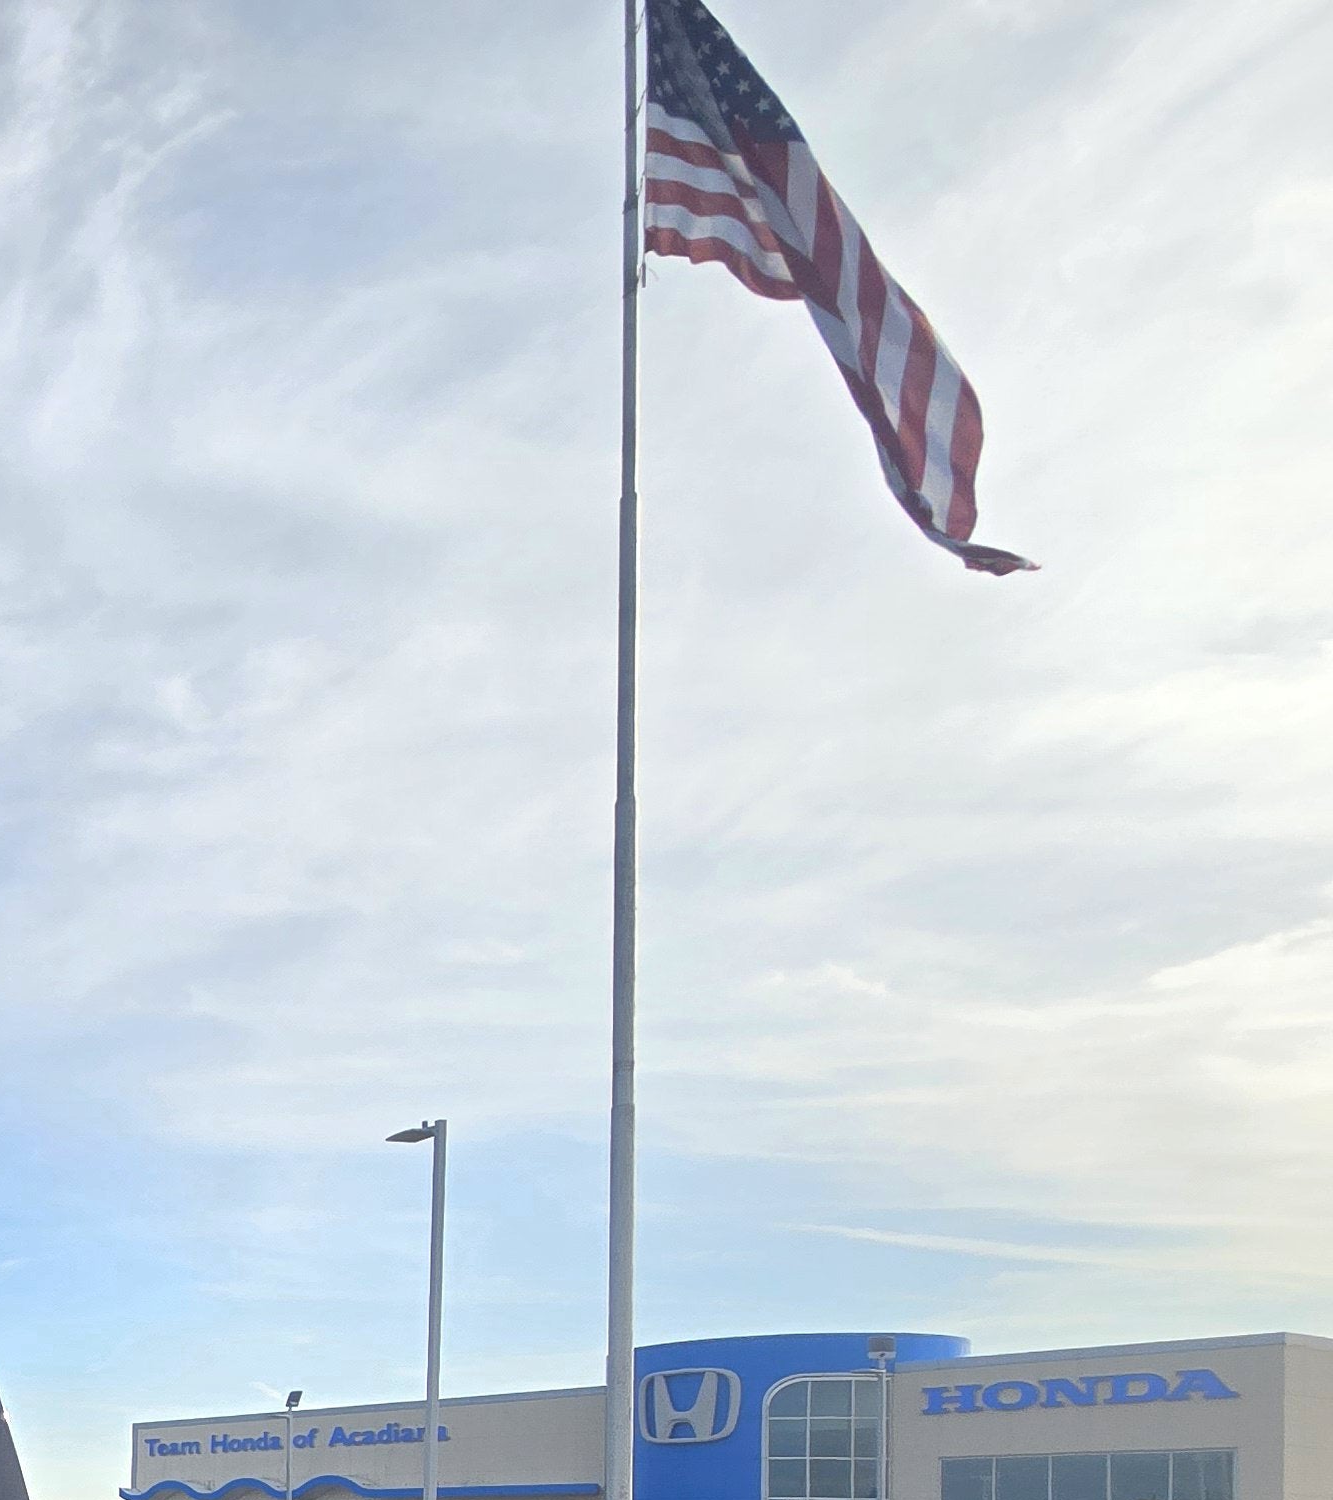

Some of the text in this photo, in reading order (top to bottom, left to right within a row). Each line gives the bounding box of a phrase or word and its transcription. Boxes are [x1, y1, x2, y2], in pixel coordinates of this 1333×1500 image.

[921, 1369, 1240, 1415] HONDA
[144, 1438, 202, 1457] Team
[210, 1431, 284, 1454] Honda
[292, 1427, 319, 1449] of
